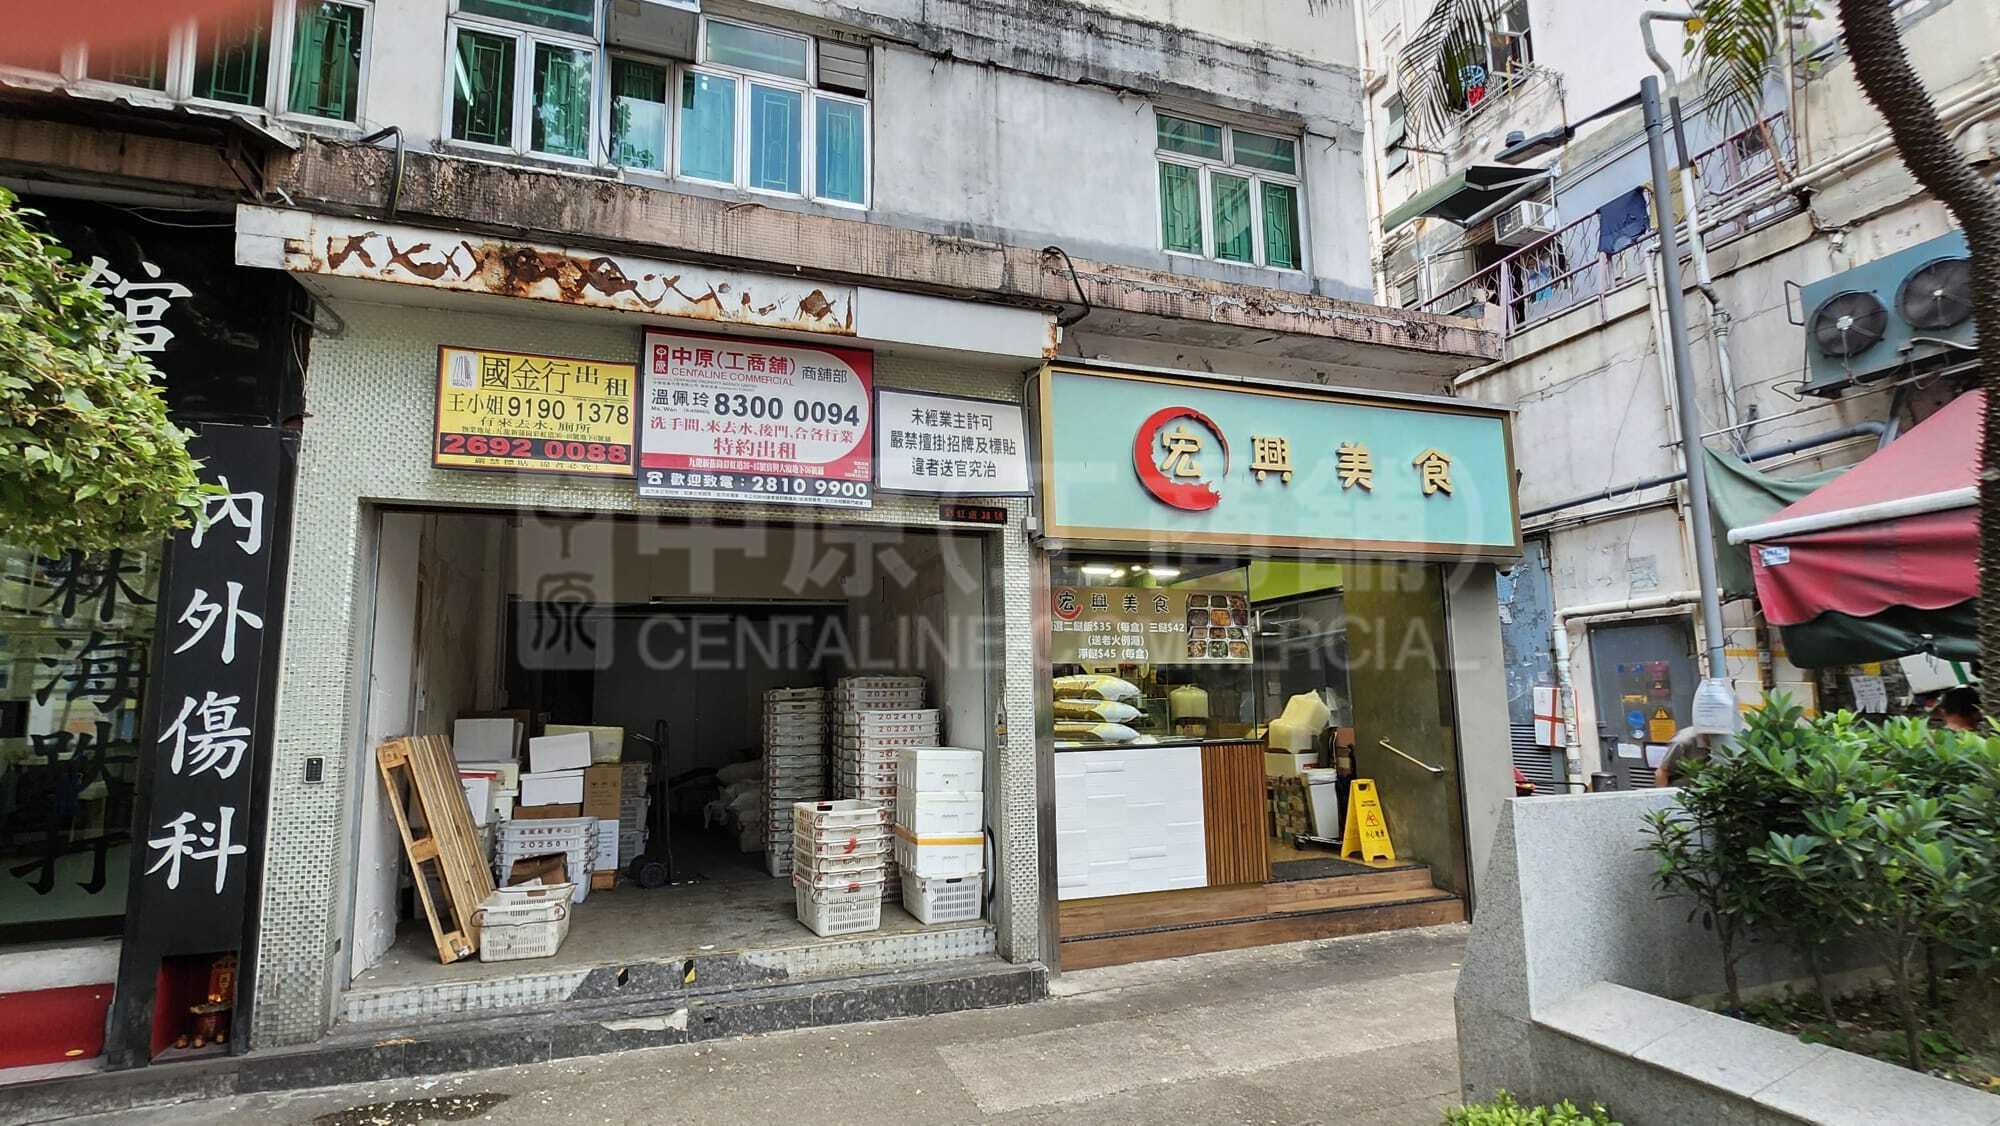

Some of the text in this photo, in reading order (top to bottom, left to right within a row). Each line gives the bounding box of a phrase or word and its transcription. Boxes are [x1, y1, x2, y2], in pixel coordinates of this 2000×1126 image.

[672, 346, 796, 377] 中原(工商舖)
[671, 367, 727, 381] CENTALINE
[730, 373, 795, 386] COMMERCIAL
[802, 366, 848, 383] 商舖部
[448, 393, 629, 425] 王小姐 9190 1378
[651, 388, 859, 426] 溫佩玲 8300 0094
[911, 407, 993, 431] 未經業主許可
[443, 434, 533, 458] 2692
[544, 440, 627, 464] 0088
[713, 437, 797, 460] 特約出租
[890, 430, 1016, 456] 嚴禁擅掛招牌及標貼
[911, 457, 996, 478] 違者送官究治
[1161, 424, 1454, 497] 宏興美食
[752, 477, 806, 493] 2810
[815, 480, 868, 498] 9900
[1059, 592, 1170, 615] 宏興美食
[520, 840, 569, 848] 202501
